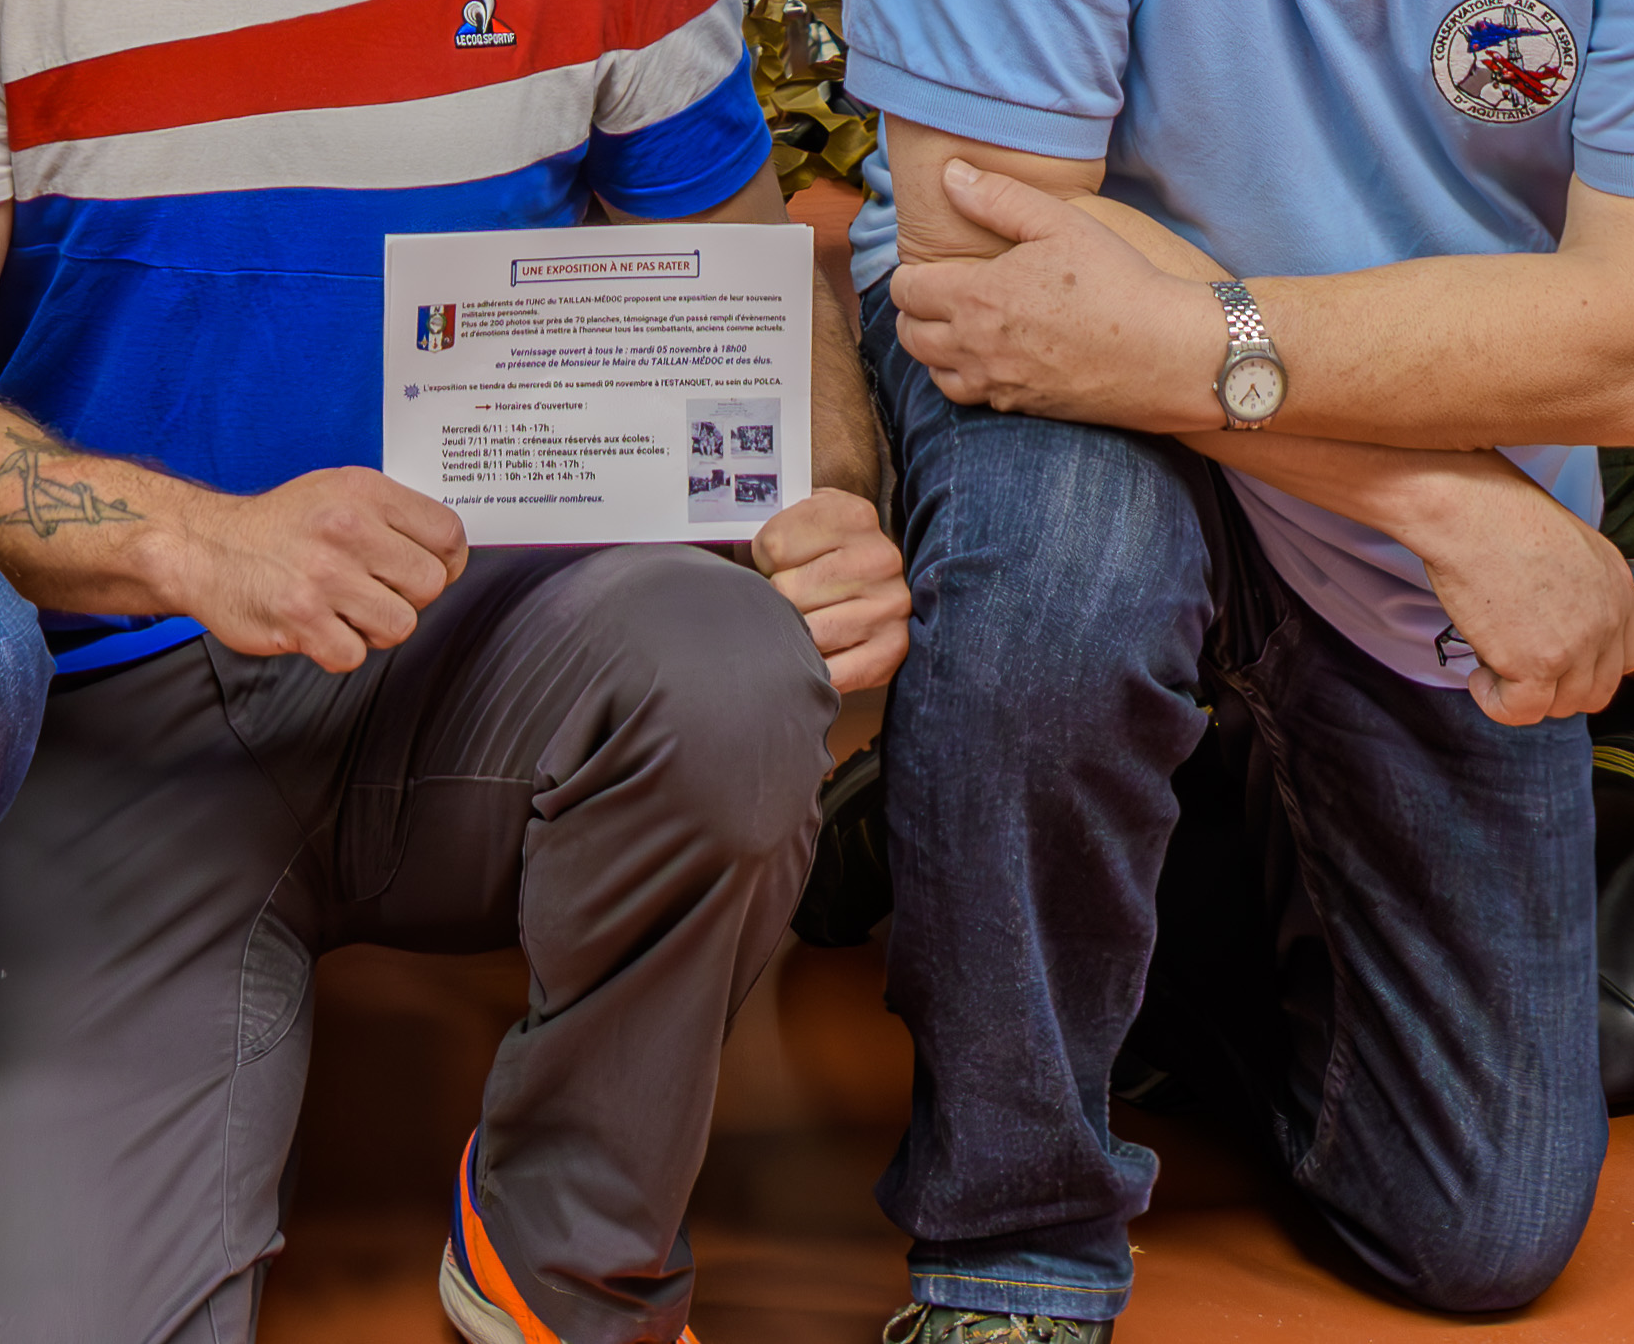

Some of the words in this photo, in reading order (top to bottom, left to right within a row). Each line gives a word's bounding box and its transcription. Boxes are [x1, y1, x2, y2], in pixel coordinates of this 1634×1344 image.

[456, 34, 466, 46] LE
[466, 34, 484, 46] COQ
[483, 32, 515, 45] SPORTIF
[1540, 9, 1556, 23] ET
[1555, 27, 1574, 67] ESPACE
[522, 266, 543, 276] UNE
[547, 263, 607, 275] EXPOSITION
[610, 261, 618, 272] À
[620, 262, 633, 272] NE
[636, 261, 656, 271] PAS
[658, 261, 690, 271] RATER
[511, 347, 557, 358] Vernissage
[559, 347, 586, 356] ouvert
[595, 346, 613, 355] tous
[615, 345, 624, 354] le
[630, 345, 656, 354] mardi
[656, 345, 668, 354] 05
[669, 345, 711, 354] novembre
[721, 344, 747, 353] 18h00
[495, 361, 506, 369] en
[507, 361, 546, 370] présence
[548, 359, 559, 367] de
[560, 359, 601, 367] Monsieur
[612, 358, 636, 366] Maire
[638, 357, 649, 366] du
[651, 355, 724, 366] TAILLAN-MÉDOC
[725, 357, 734, 365] et
[736, 356, 751, 365] des
[753, 355, 773, 365] élus.
[495, 401, 532, 411] Horaires
[534, 401, 583, 411] d'ouverture
[442, 425, 481, 434] Mercredi
[482, 424, 502, 433] 6/11
[511, 424, 527, 433] 14h
[442, 437, 466, 446] Jeudi
[468, 436, 488, 445] 7/11
[490, 436, 516, 445] matin
[522, 436, 562, 445] créneaux
[564, 435, 602, 444] réservés
[621, 434, 650, 443] écoles
[442, 449, 481, 458] Vendredi
[482, 448, 503, 457] 8/11
[505, 448, 530, 457] matin
[537, 447, 577, 456] créneaux
[579, 447, 617, 456] réservés
[618, 447, 635, 455] aux
[636, 446, 665, 455] écoles
[442, 461, 481, 470] Vendredi
[482, 460, 503, 469] 8/11
[505, 460, 533, 469] Public
[540, 460, 557, 468] 14h
[442, 473, 475, 482] Samedi
[476, 473, 496, 481] 9/11
[505, 472, 521, 481] 10h
[546, 473, 555, 481] et
[557, 472, 573, 481] 14h
